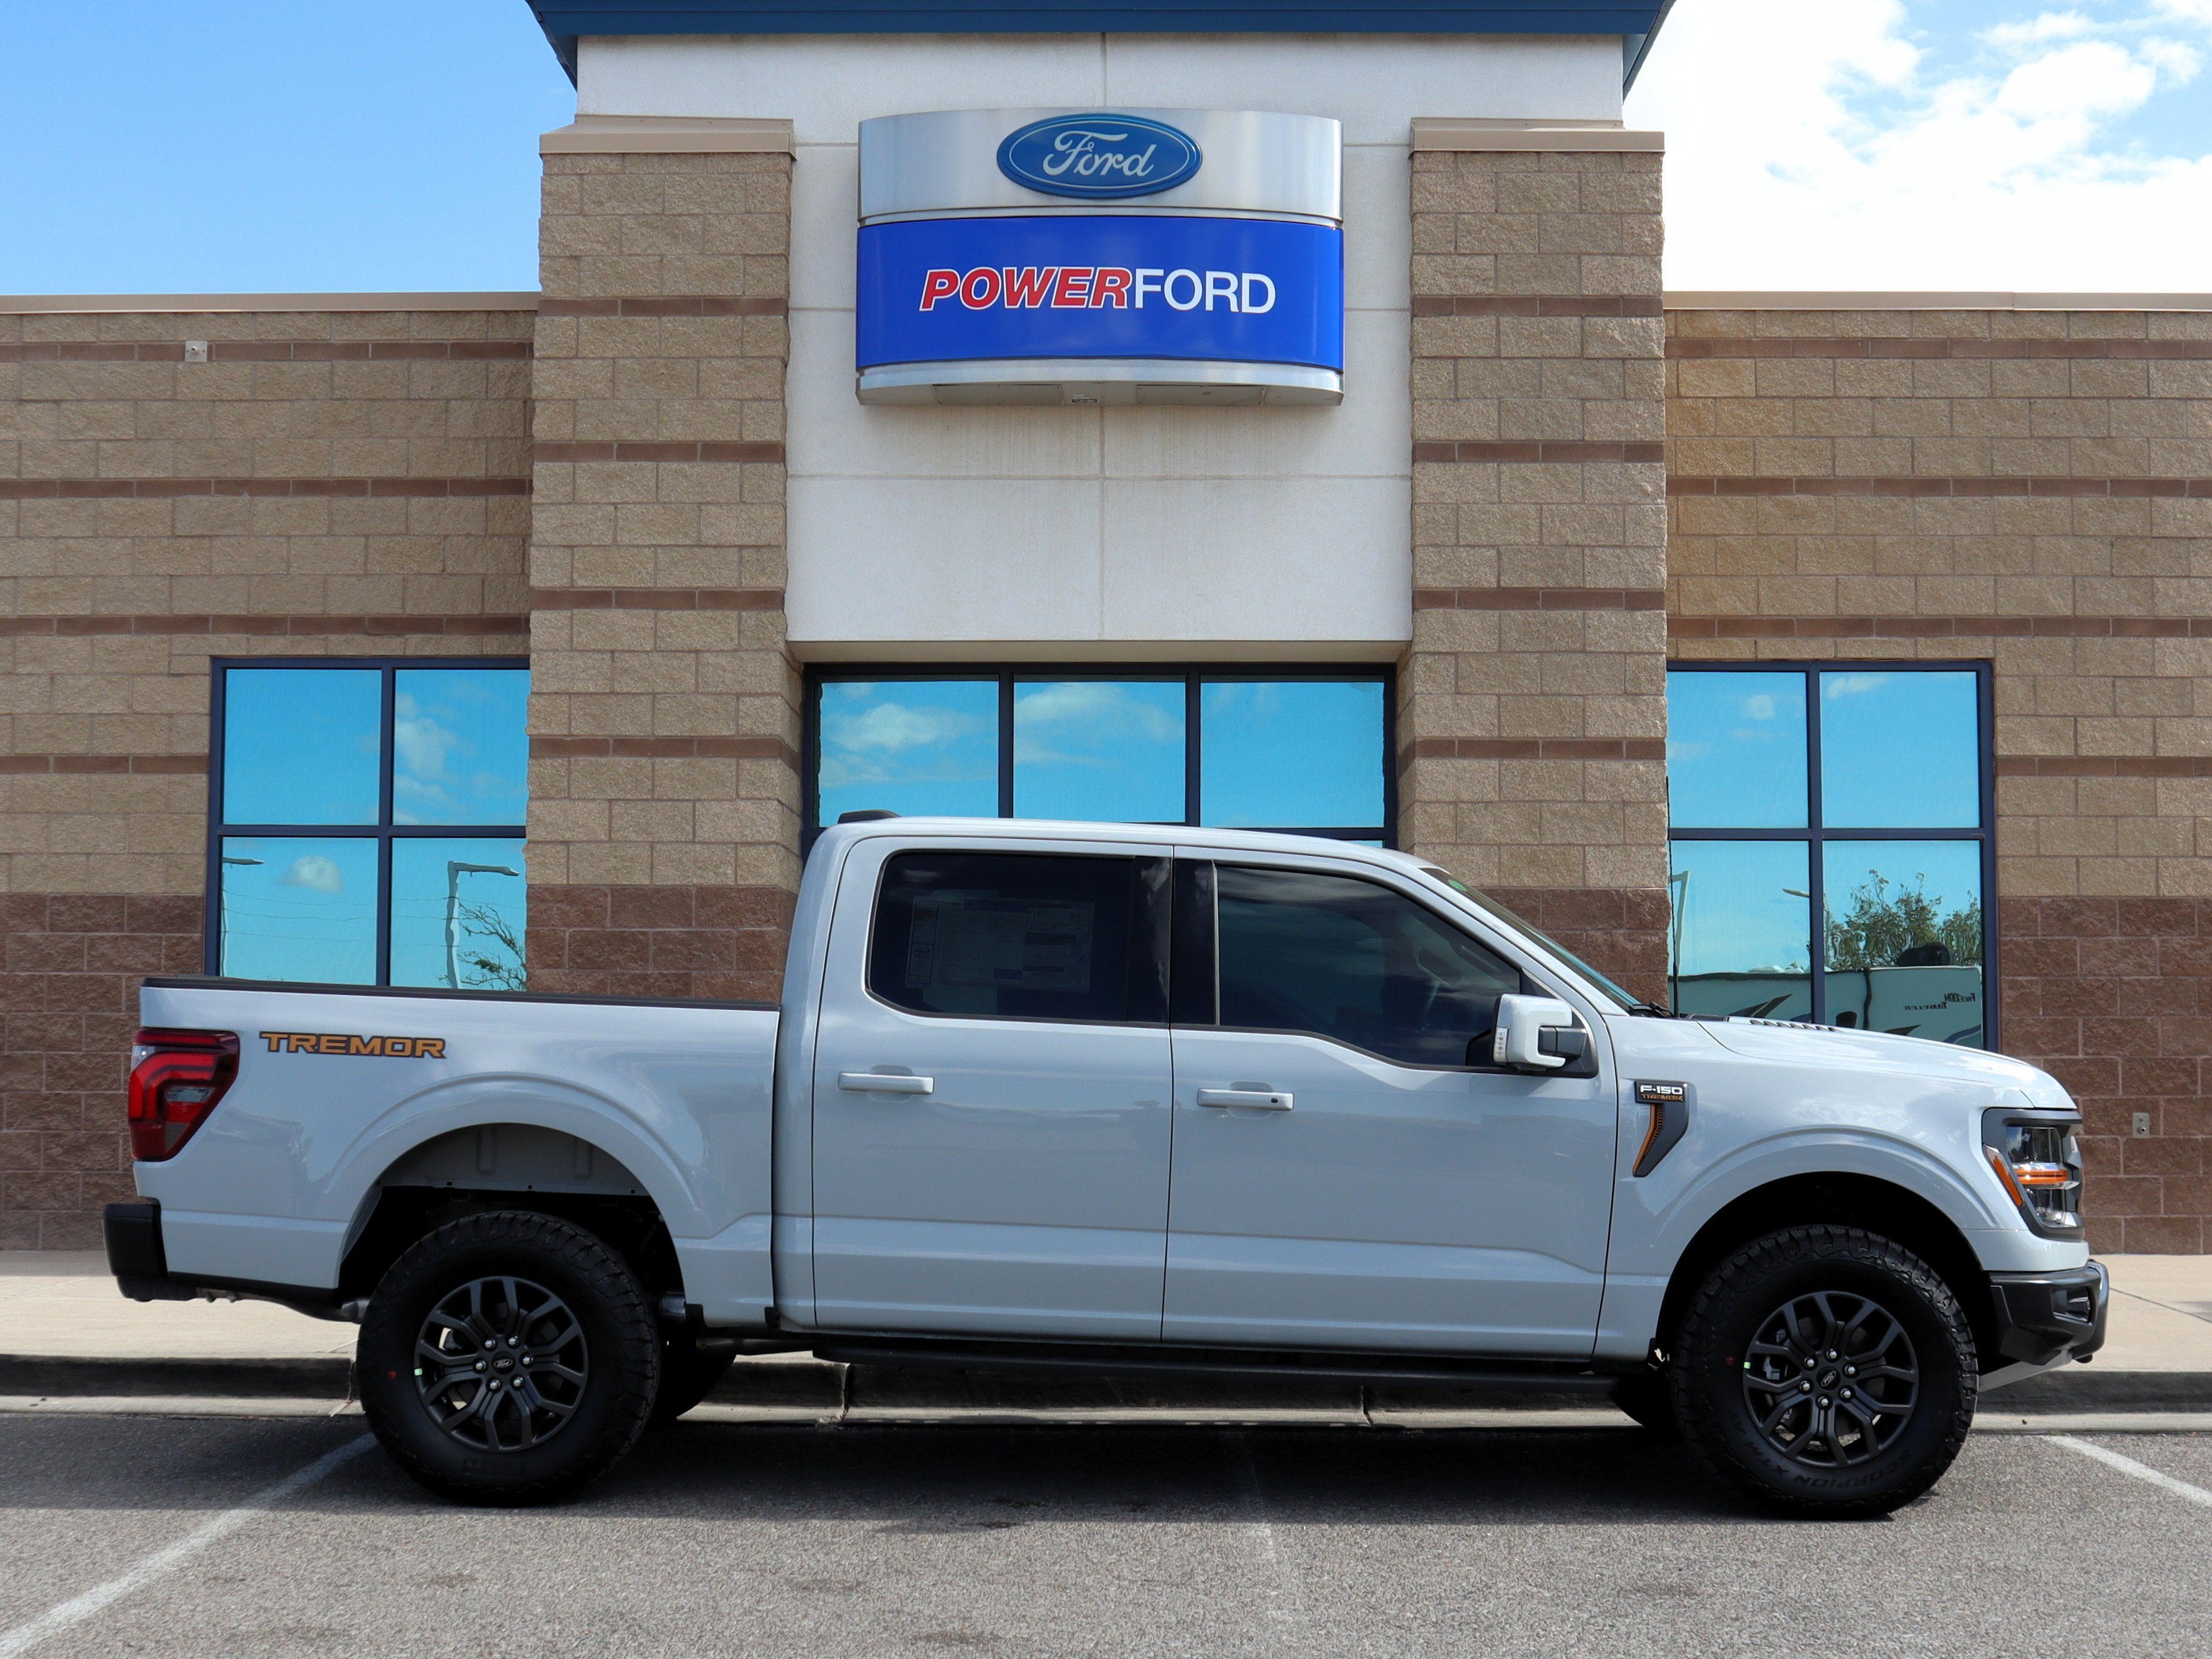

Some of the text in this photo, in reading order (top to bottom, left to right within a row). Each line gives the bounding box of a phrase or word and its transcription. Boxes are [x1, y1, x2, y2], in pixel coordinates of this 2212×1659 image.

[1043, 130, 1157, 177] Ford
[259, 1031, 447, 1059] TREMOR
[1640, 1085, 1683, 1095] F-150
[1794, 1452, 1910, 1487] SCORPION
